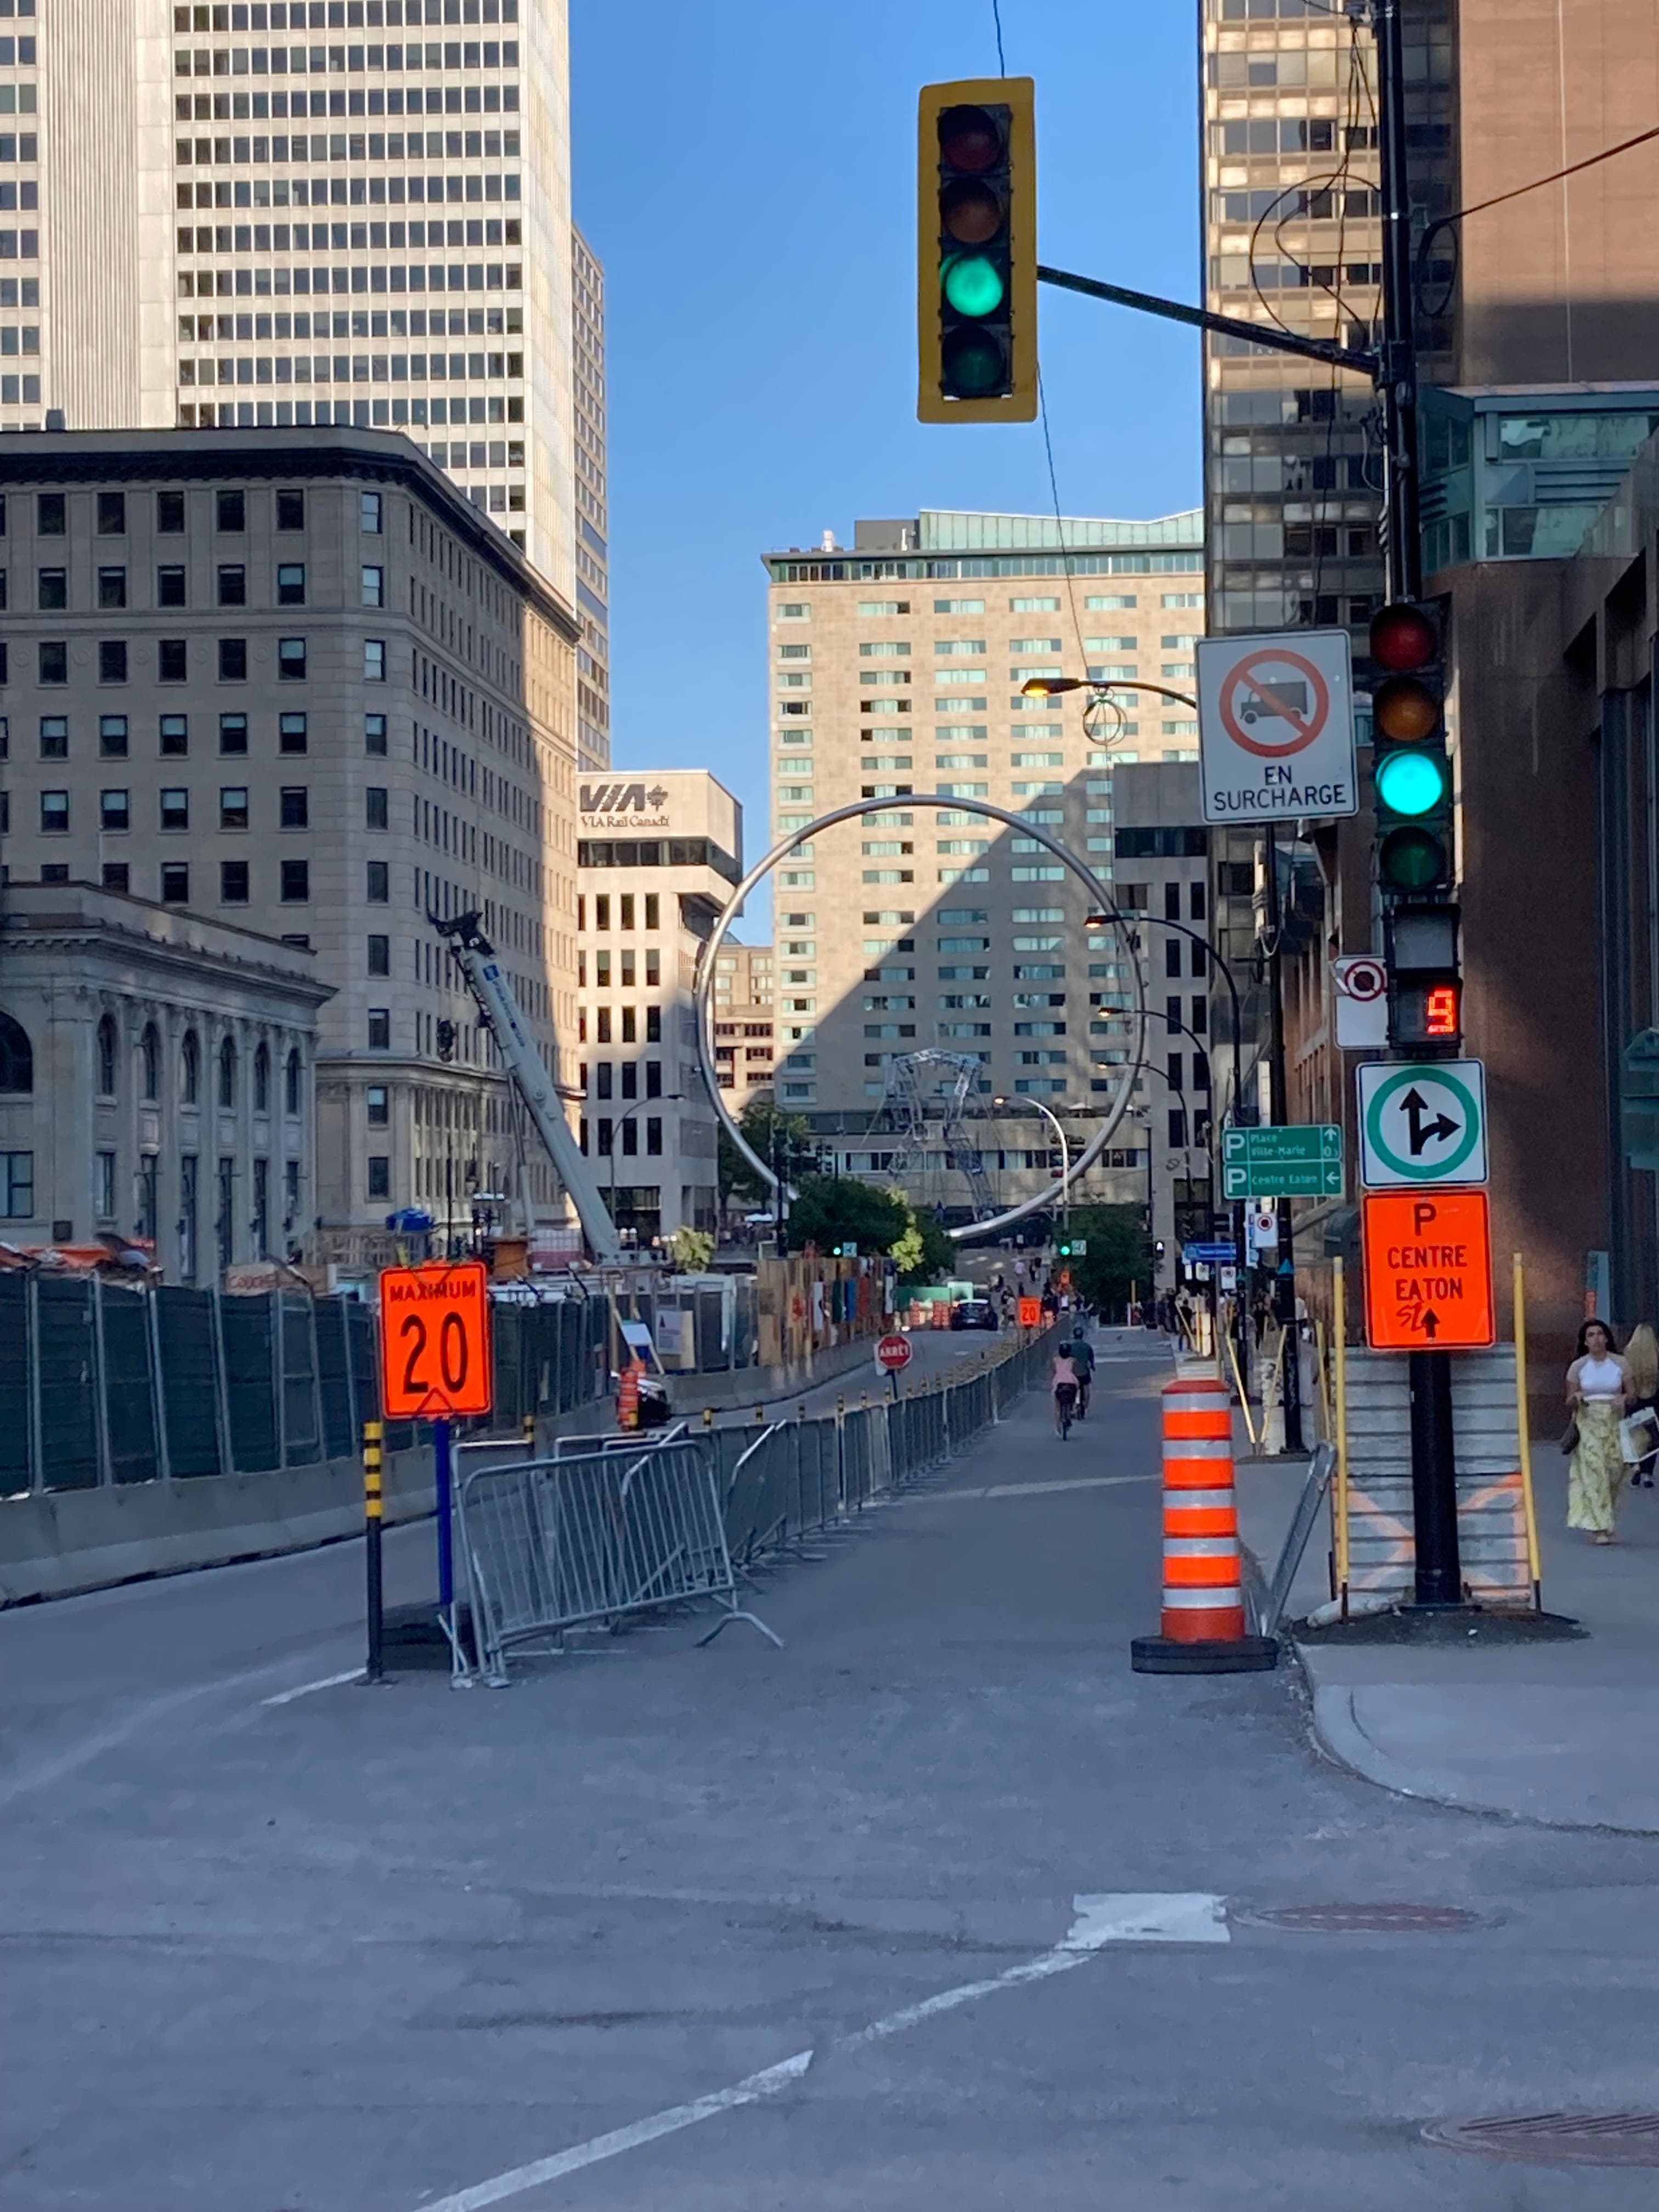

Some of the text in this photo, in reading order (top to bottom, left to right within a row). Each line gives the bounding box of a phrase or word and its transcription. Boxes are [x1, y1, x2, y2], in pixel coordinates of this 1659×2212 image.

[1265, 765, 1292, 786] EN
[580, 783, 646, 812] VIA
[1214, 785, 1346, 811] SURCHARGE
[580, 816, 605, 827] VIA
[1226, 1133, 1245, 1159] P
[1227, 1168, 1247, 1193] P
[1251, 1176, 1285, 1185] Centre
[1414, 1203, 1436, 1236] P
[1387, 1245, 1467, 1269] CENTRE
[390, 1279, 476, 1302] MAXIMUM
[1395, 1277, 1463, 1301] EATON
[1022, 1306, 1036, 1321] 20
[400, 1312, 468, 1394] 20
